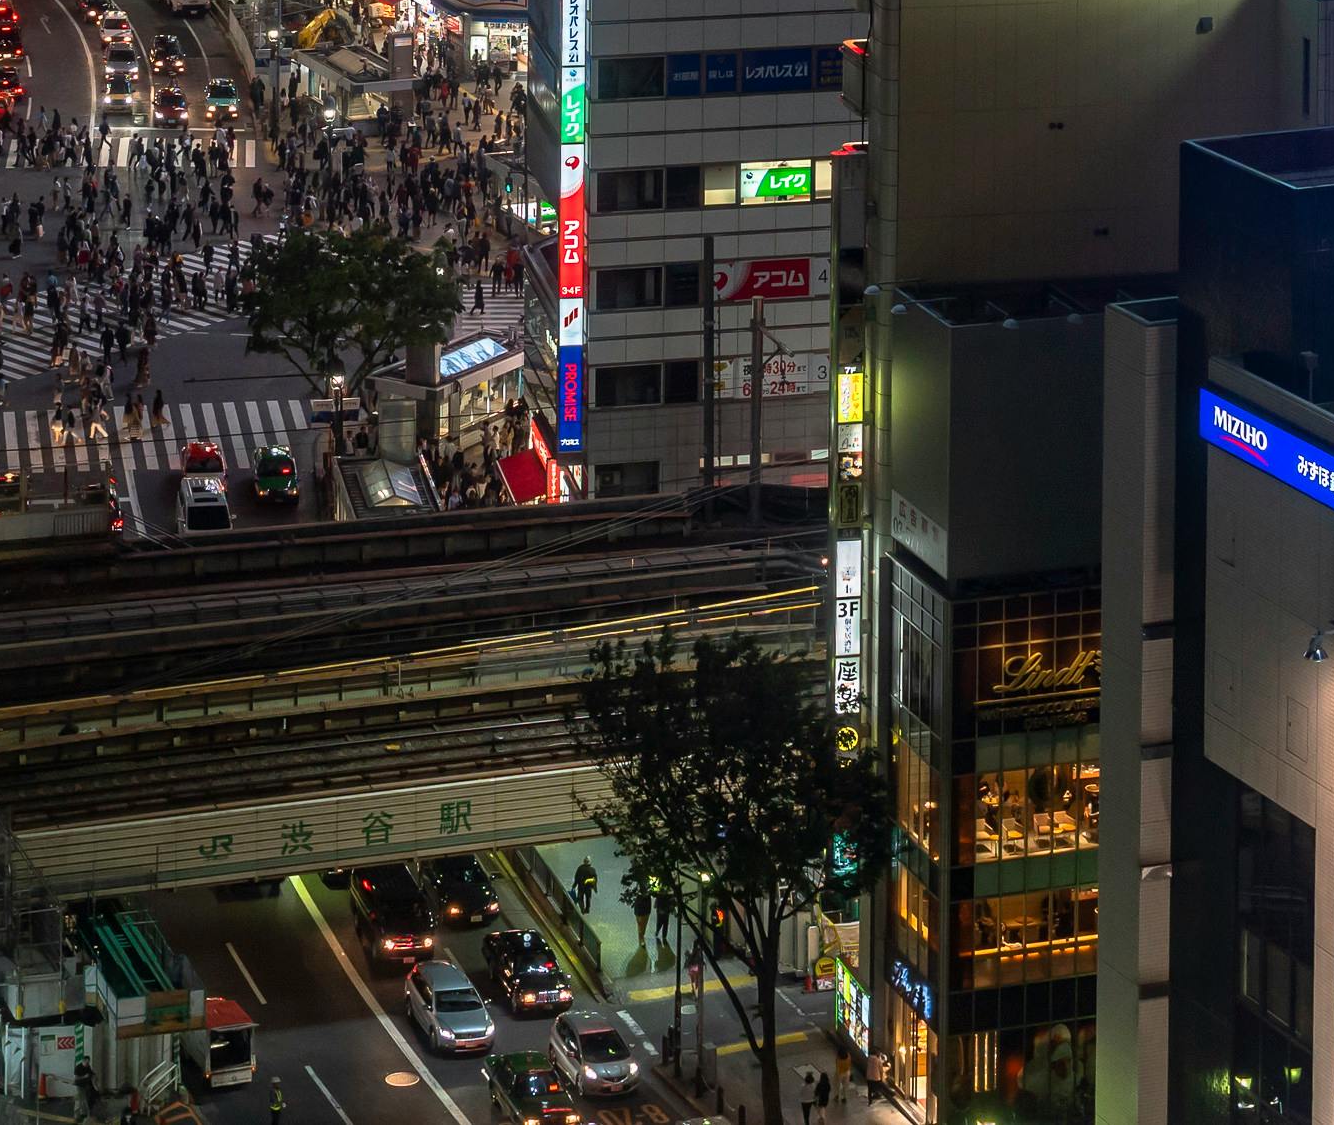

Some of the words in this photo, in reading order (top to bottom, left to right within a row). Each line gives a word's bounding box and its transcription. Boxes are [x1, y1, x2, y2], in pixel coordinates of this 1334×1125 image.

[565, 92, 581, 137] レイク
[769, 173, 807, 189] レイク
[563, 220, 580, 266] アコム
[752, 270, 806, 289] アコム
[564, 362, 578, 423] PROMISE
[1212, 405, 1269, 452] MIZUHO
[837, 601, 859, 618] 3F
[992, 651, 1095, 694] Lindt
[198, 834, 234, 861] JR
